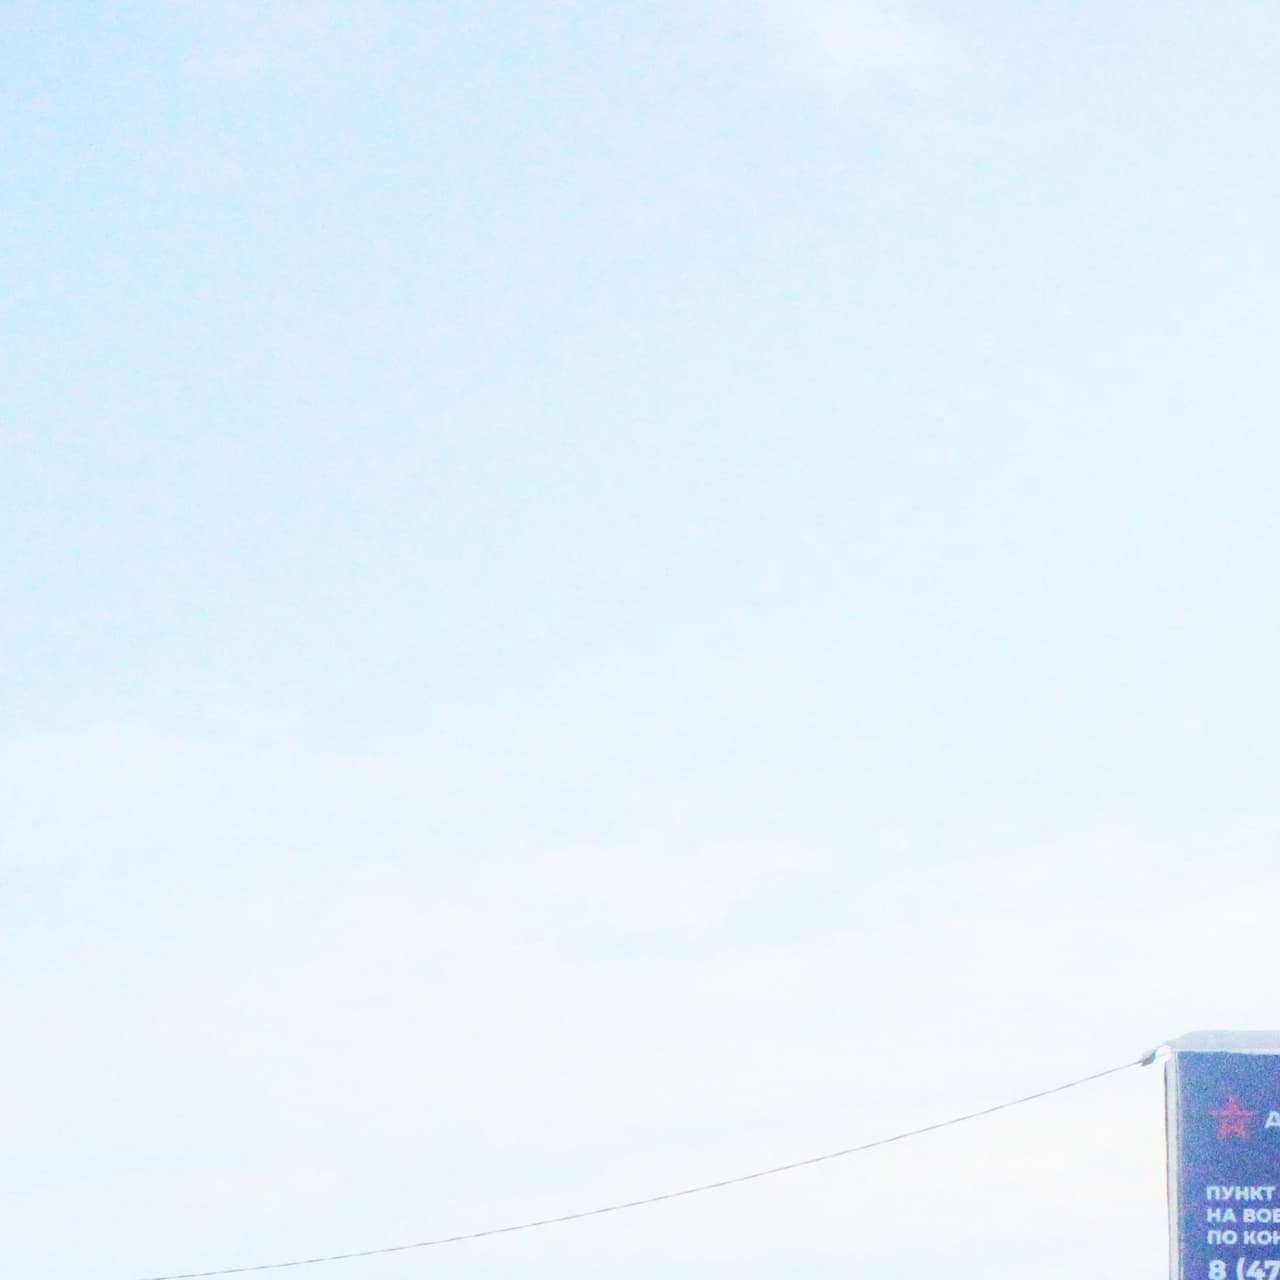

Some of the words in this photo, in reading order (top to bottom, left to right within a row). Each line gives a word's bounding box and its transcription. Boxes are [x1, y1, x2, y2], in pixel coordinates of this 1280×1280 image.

[1206, 1186, 1276, 1201] ПУНКТ
[1206, 1209, 1237, 1223] НА
[1206, 1231, 1237, 1245] ПО
